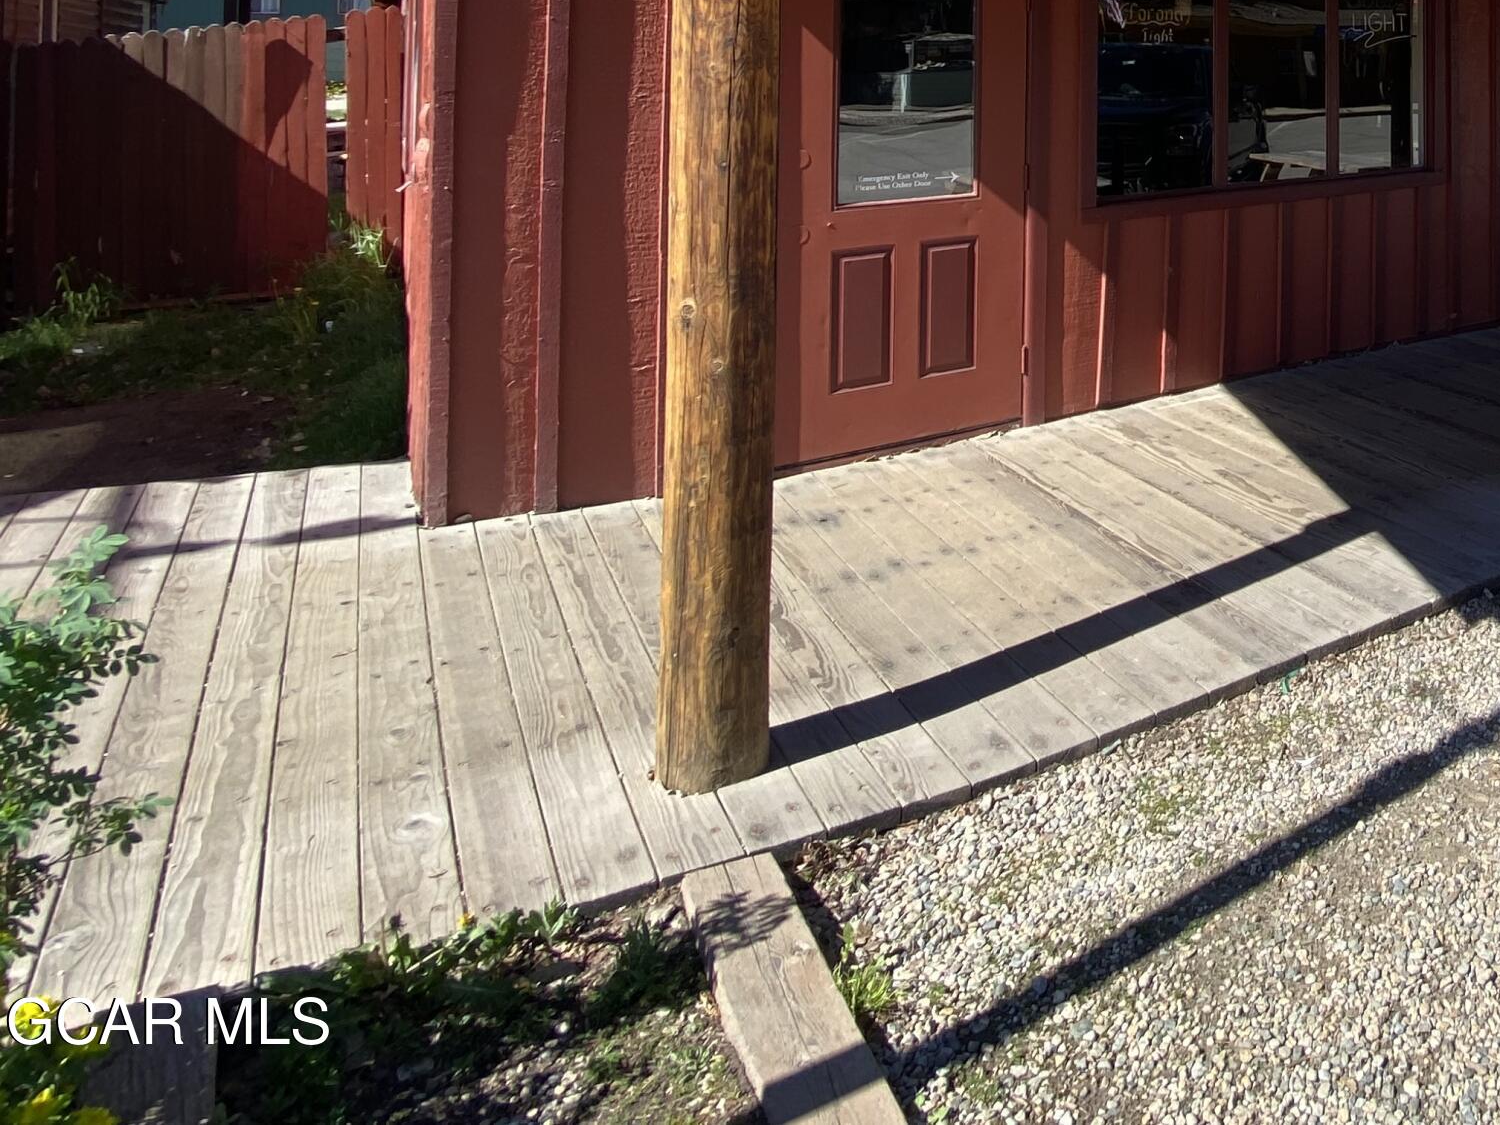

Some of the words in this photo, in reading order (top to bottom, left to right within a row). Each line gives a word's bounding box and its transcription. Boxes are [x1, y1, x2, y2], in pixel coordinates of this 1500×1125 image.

[1120, 3, 1187, 24] Corona
[1352, 13, 1408, 32] LIGHT
[857, 174, 895, 183] Emergency
[897, 172, 910, 180] Exit
[912, 171, 929, 180] Only
[855, 183, 876, 191] Please
[878, 182, 890, 190] Use
[892, 181, 912, 189] Other
